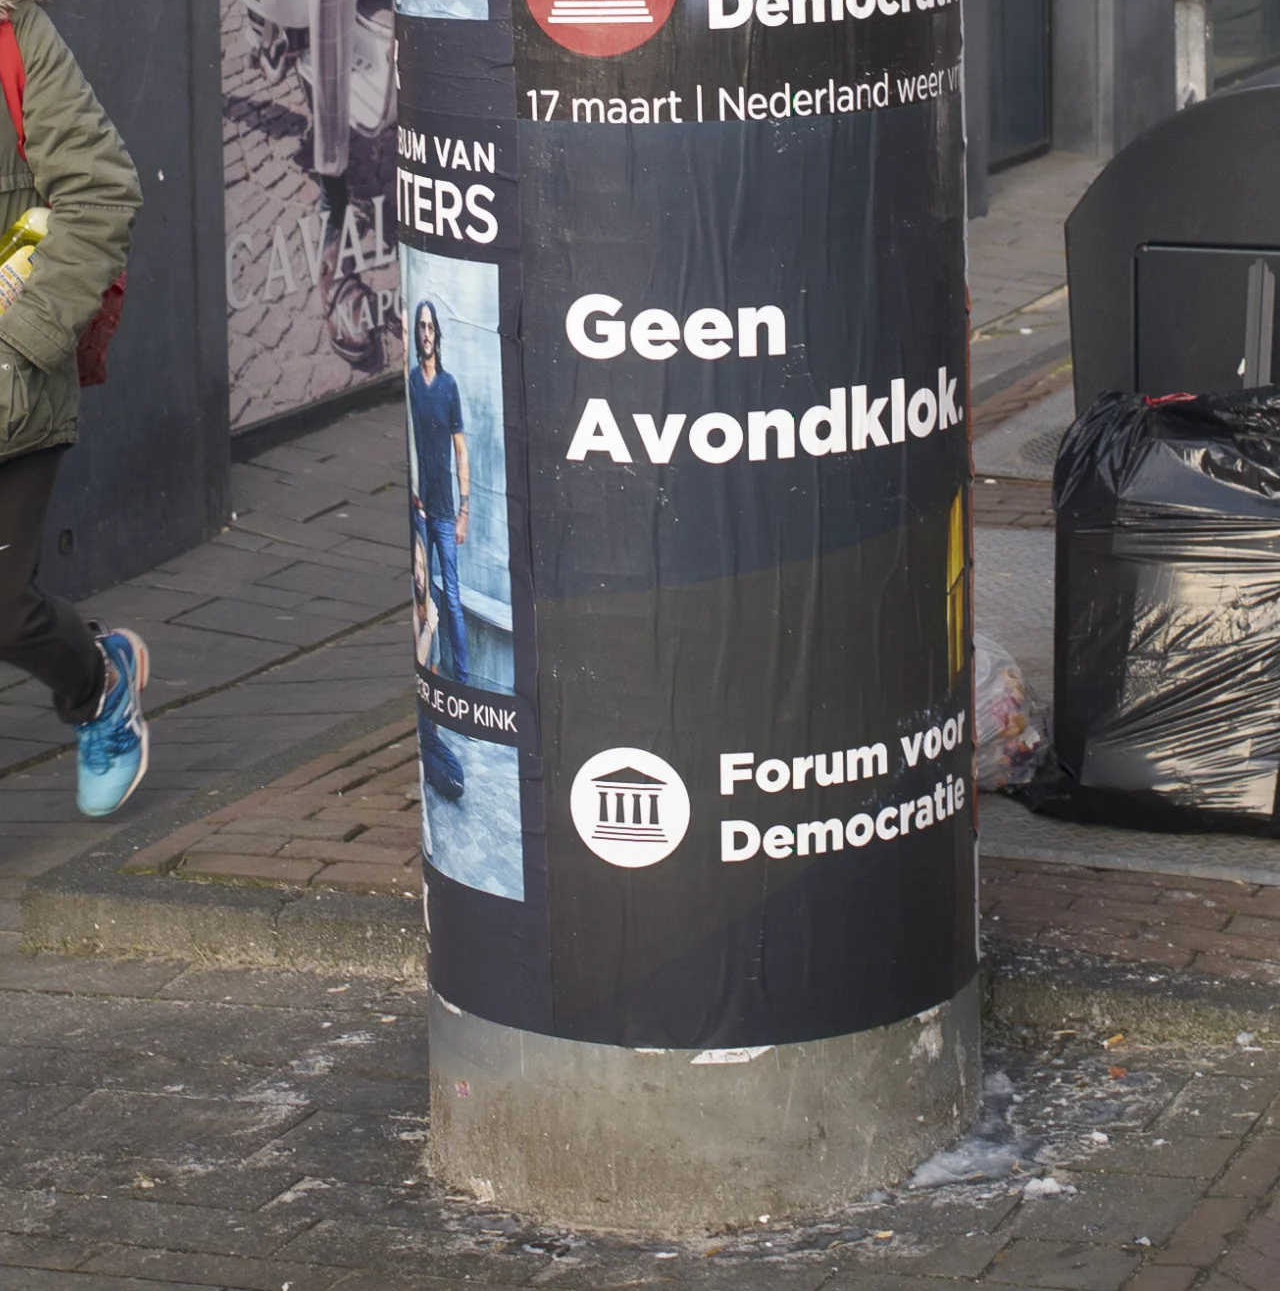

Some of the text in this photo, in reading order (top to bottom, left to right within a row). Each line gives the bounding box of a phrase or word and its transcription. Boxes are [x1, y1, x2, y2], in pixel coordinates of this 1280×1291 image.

[527, 90, 559, 121] 17
[572, 91, 682, 123] maart
[719, 73, 888, 121] Nederland
[896, 70, 945, 104] weer
[432, 135, 496, 174] VAN
[566, 294, 785, 360] Geen
[566, 365, 964, 464] Avondklok.
[431, 689, 445, 713] JE
[447, 696, 469, 720] OP
[473, 703, 518, 733] KINK
[720, 709, 966, 796] Forum voor
[720, 773, 966, 862] Democratie
